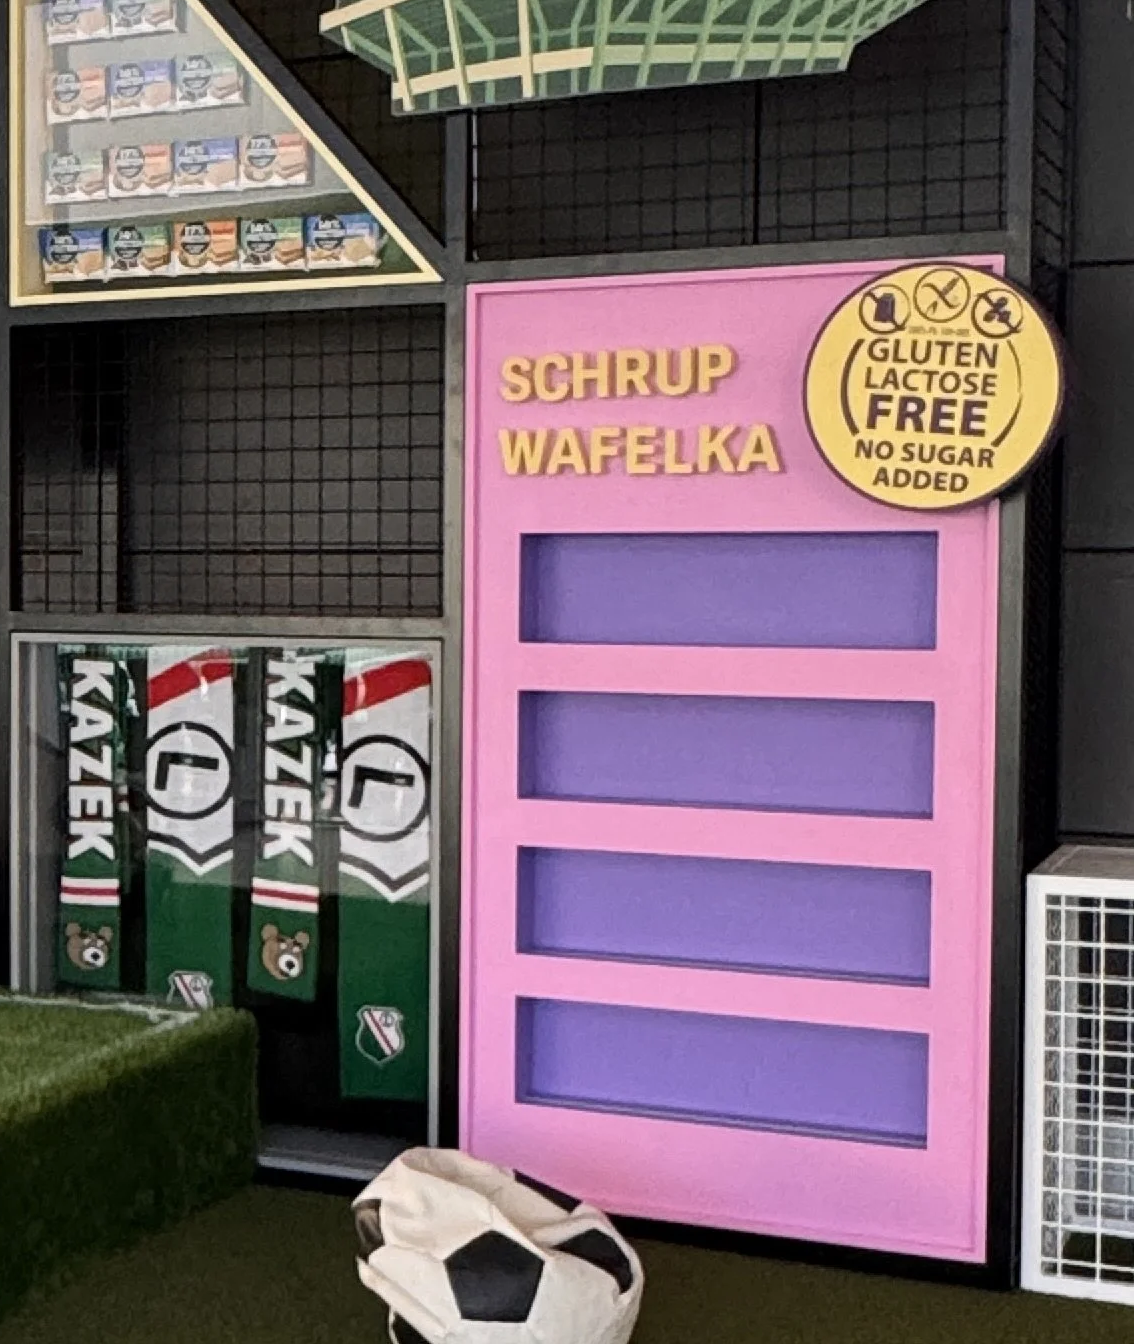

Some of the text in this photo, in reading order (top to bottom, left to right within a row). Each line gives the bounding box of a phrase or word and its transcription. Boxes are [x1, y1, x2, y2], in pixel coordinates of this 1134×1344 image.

[500, 343, 736, 403] SCHRUP
[867, 338, 999, 369] GLUTEN
[865, 366, 998, 397] LACTOSE
[866, 393, 989, 437] FREE
[498, 422, 783, 476] WAFELKA
[854, 439, 995, 468] NO SUGAR
[872, 466, 970, 493] ADDED
[68, 658, 116, 861] KAZEK
[154, 751, 219, 791] L
[263, 656, 315, 867] KAZEK
[348, 765, 415, 808] L
